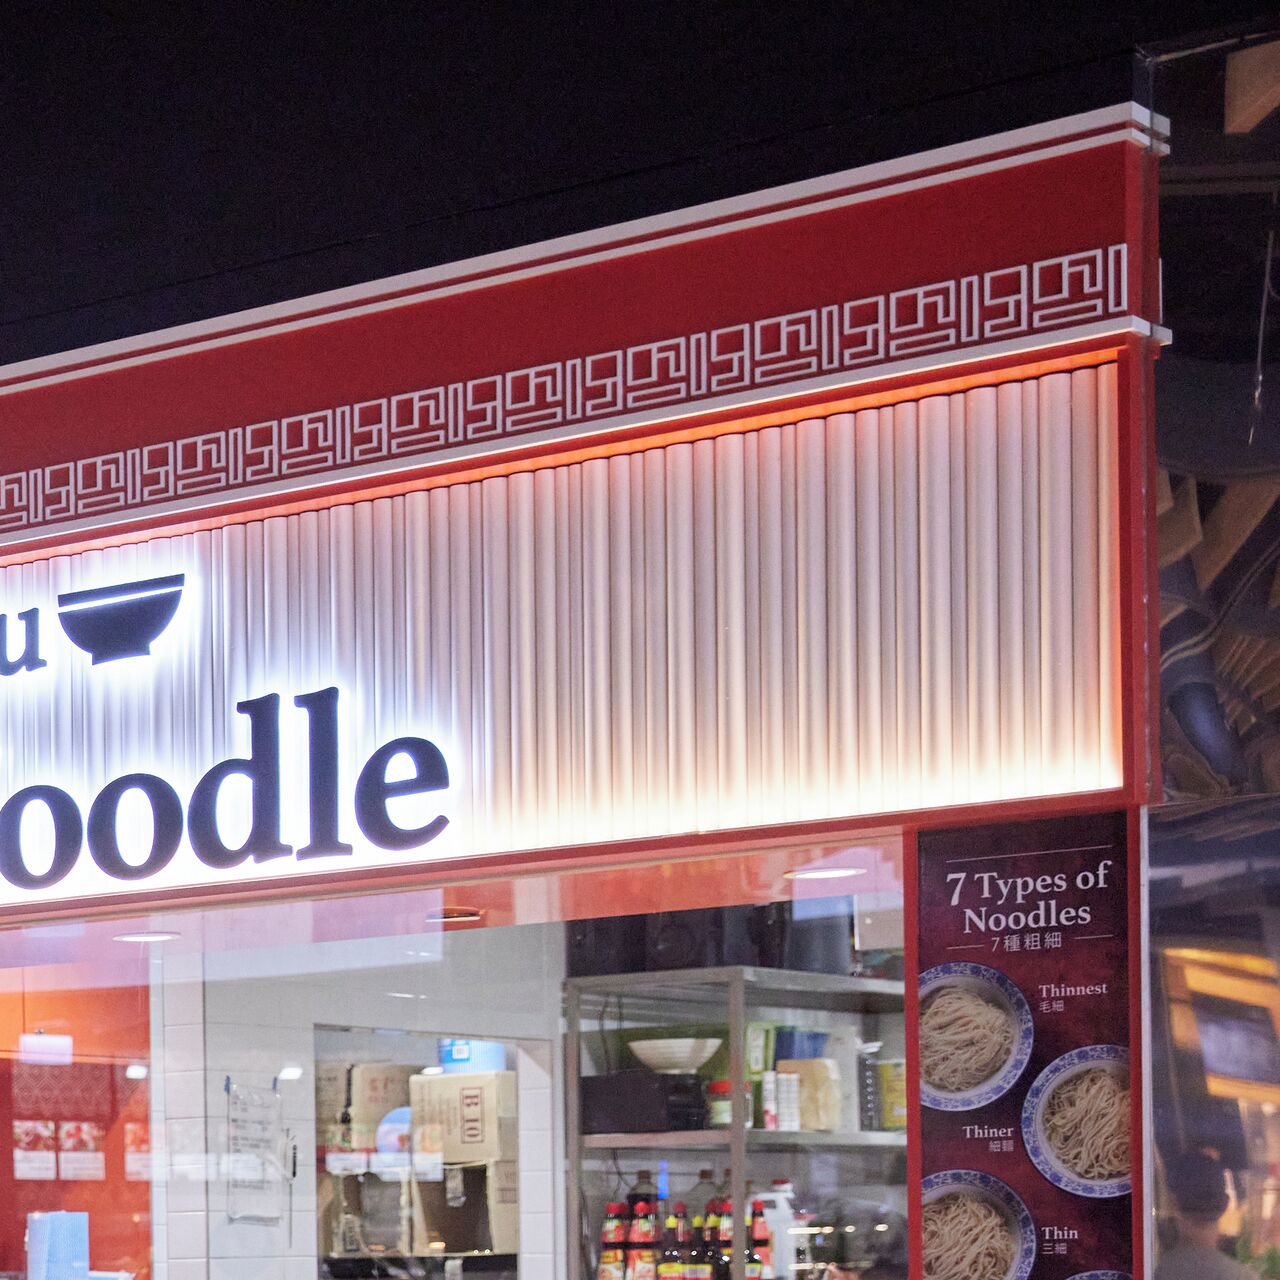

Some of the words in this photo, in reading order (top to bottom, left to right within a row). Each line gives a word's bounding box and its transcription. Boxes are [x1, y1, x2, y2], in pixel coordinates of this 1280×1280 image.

[946, 872, 967, 905] 7
[974, 867, 1067, 904] Types
[1076, 860, 1112, 890] of
[963, 900, 1091, 934] Noodles
[1038, 982, 1108, 998] Thinnest
[1039, 1000, 1064, 1013] 毛細
[962, 1126, 1014, 1139] Thiner
[1041, 1226, 1079, 1240] Thin
[1041, 1241, 1067, 1255] 三細
